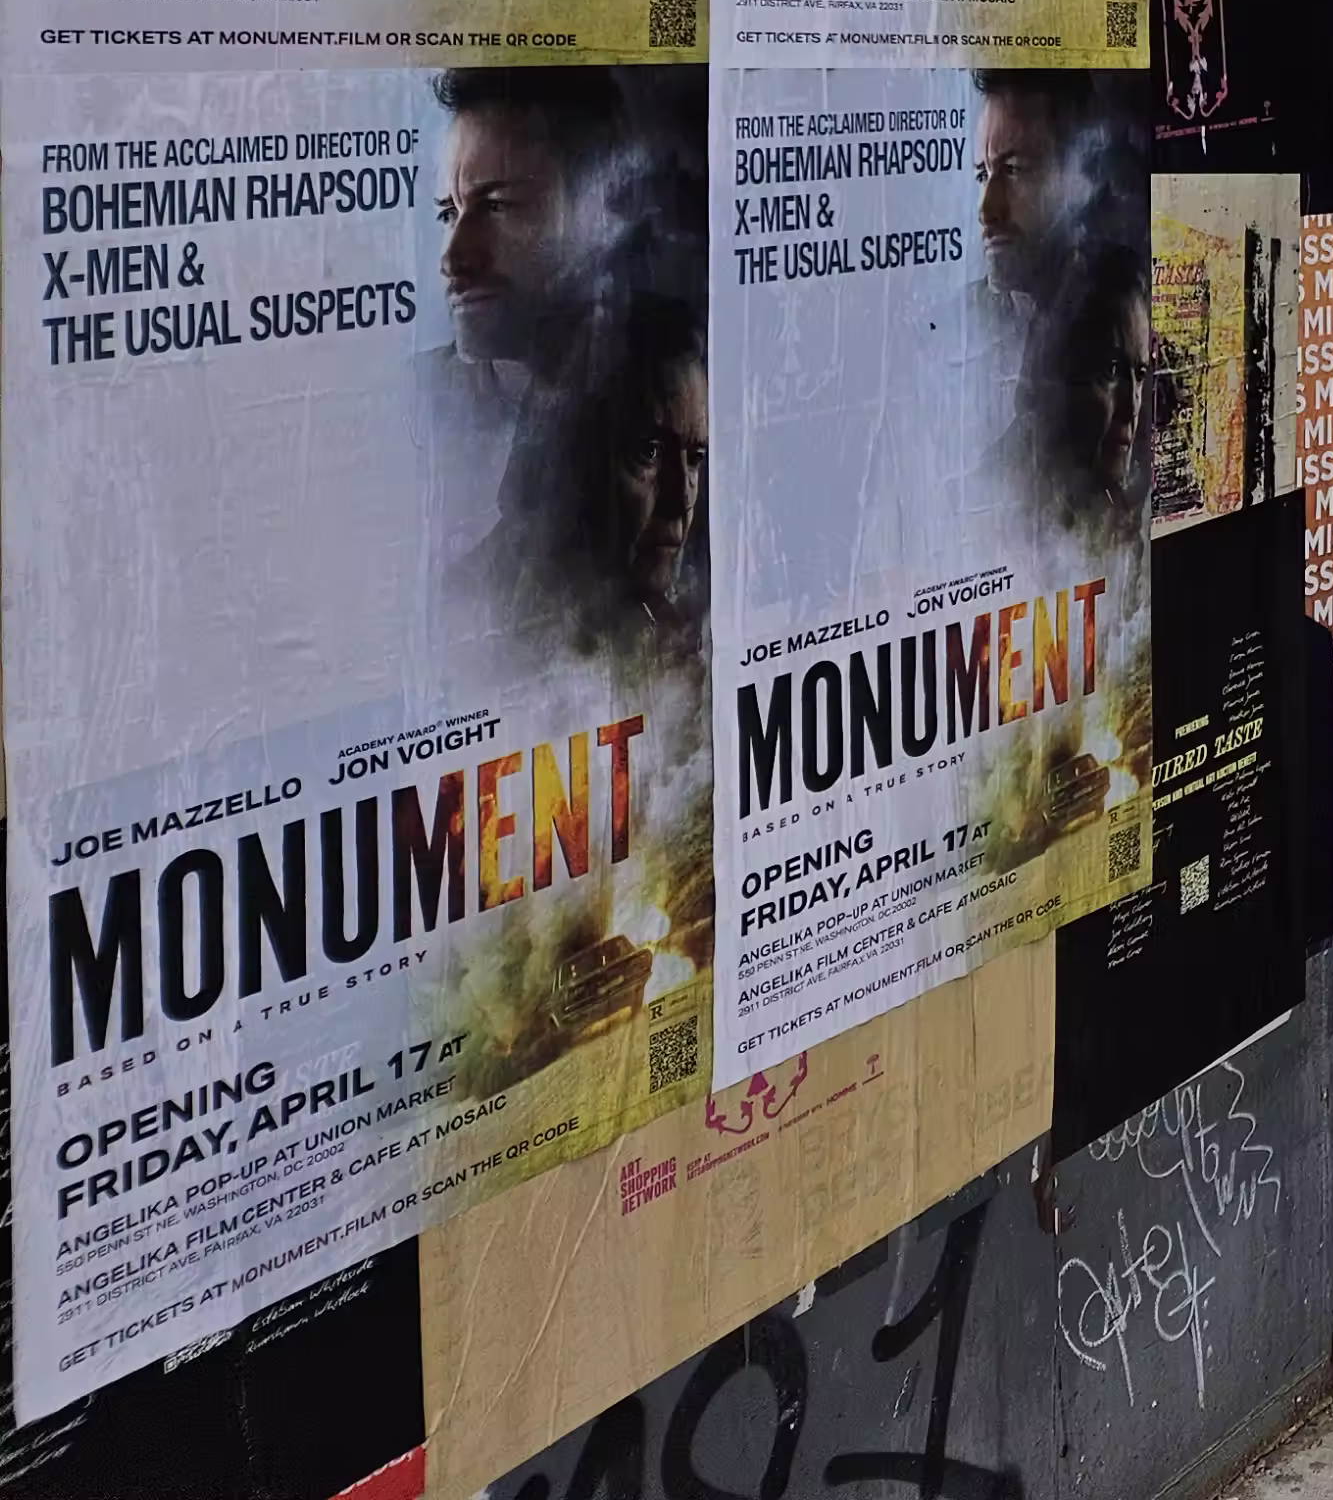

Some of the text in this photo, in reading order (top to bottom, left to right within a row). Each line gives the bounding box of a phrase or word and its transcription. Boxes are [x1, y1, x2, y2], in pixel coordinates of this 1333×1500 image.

[41, 30, 576, 46] GET TICKETS AT MONUMENT.FILM OR SCAN THE QR CODE
[736, 137, 966, 185] BOHEMIAN RHAPSODY
[43, 166, 418, 235] BOHEMIAN RHAPSODY
[43, 241, 204, 300] X-MEN &
[735, 227, 962, 285] THE USUAL SUSPECTS
[43, 280, 416, 366] THE USUAL SUSPECTS
[737, 577, 1107, 820] MONUMENT
[1175, 714, 1209, 739] PREMIERING
[329, 718, 501, 787] JON VOIGHT
[1214, 717, 1263, 758] TASTE
[52, 776, 303, 868] JOE MAZZELLO
[50, 714, 645, 1068] MONUMENT
[57, 1060, 276, 1172] OPENING
[57, 1040, 433, 1221] FRIDAY, APRIL 17
[620, 1158, 641, 1180] ART
[620, 1156, 676, 1198] SHOPPING
[703, 1153, 711, 1164] AT
[621, 1173, 676, 1216] NETWORK
